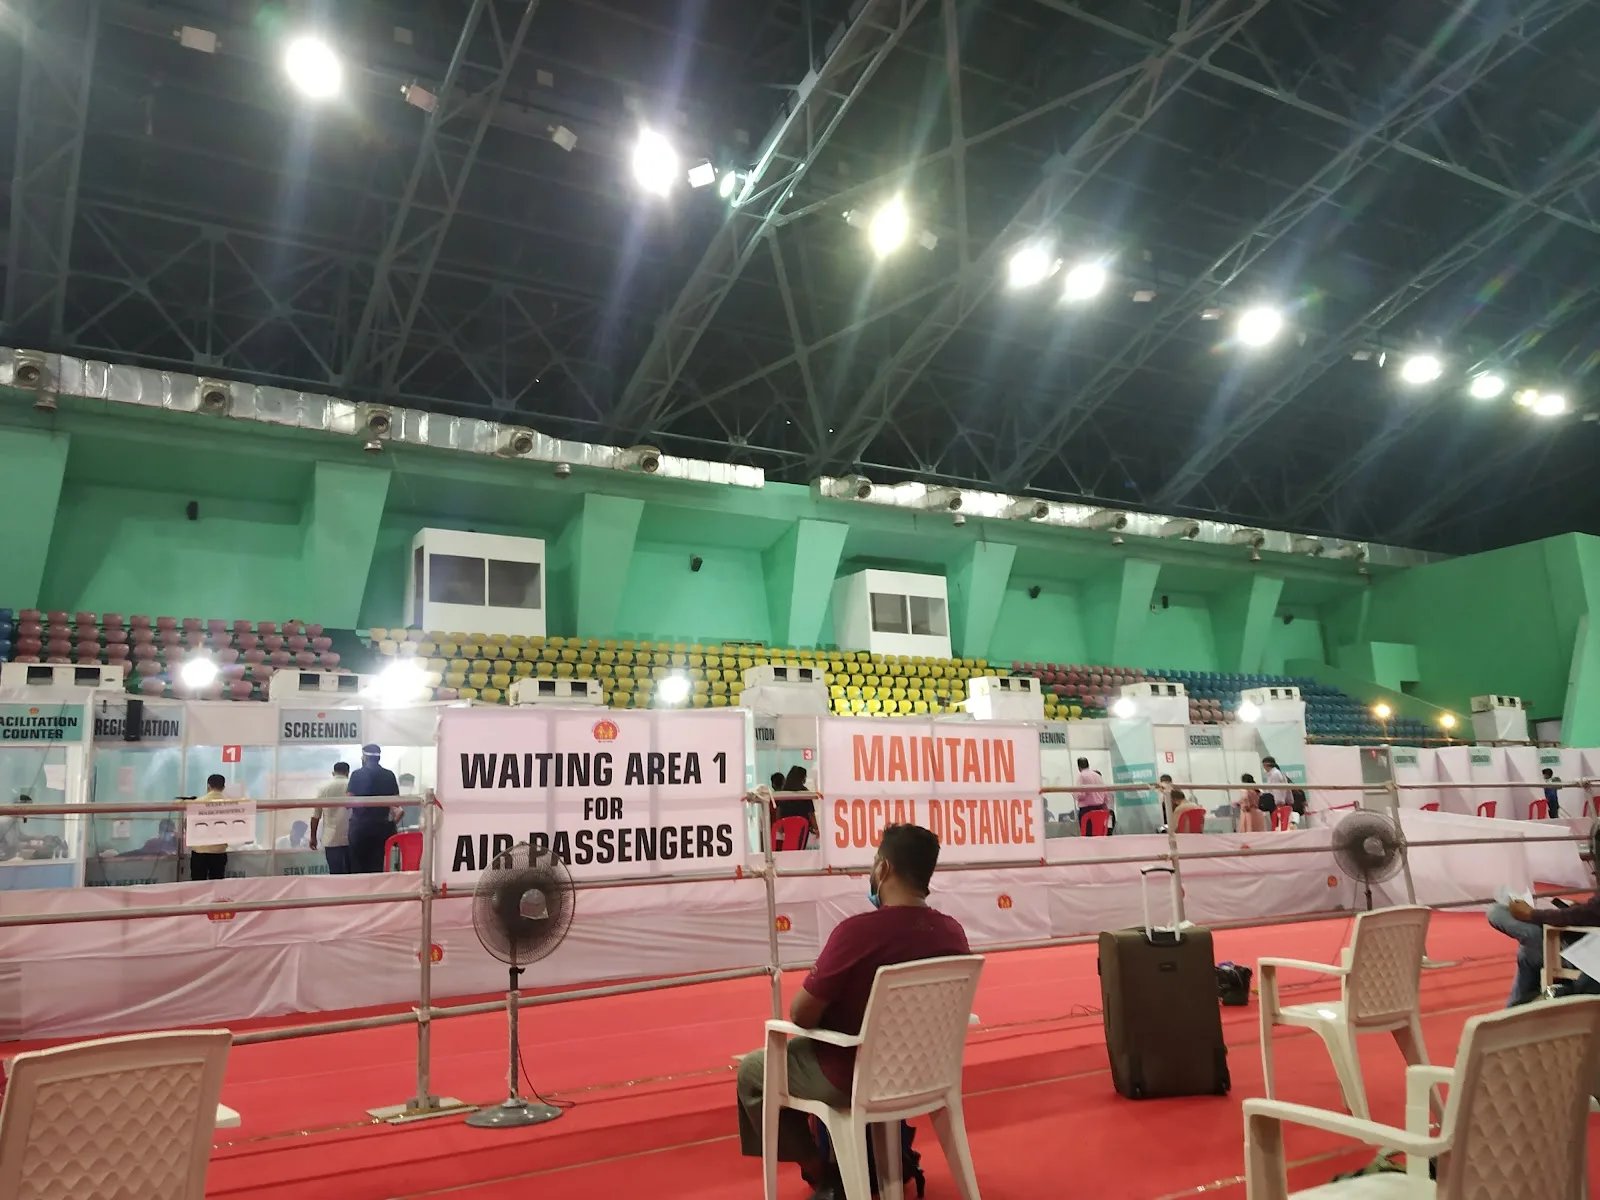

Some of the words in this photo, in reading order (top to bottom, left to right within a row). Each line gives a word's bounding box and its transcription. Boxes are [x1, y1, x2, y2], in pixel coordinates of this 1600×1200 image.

[3, 728, 64, 739] COUNTER
[284, 721, 358, 738] SCREENING
[1189, 734, 1222, 746] SCREENING
[226, 747, 237, 761] 1
[804, 749, 813, 761] 3
[853, 734, 1016, 783] MAINTAIN
[460, 752, 613, 789] WAITING
[624, 751, 702, 786] AREA
[712, 752, 727, 784] 1
[583, 797, 624, 821] FOR
[928, 799, 1036, 846] DISTANCE
[452, 833, 514, 872] AIR
[529, 824, 733, 868] PASSENGERS
